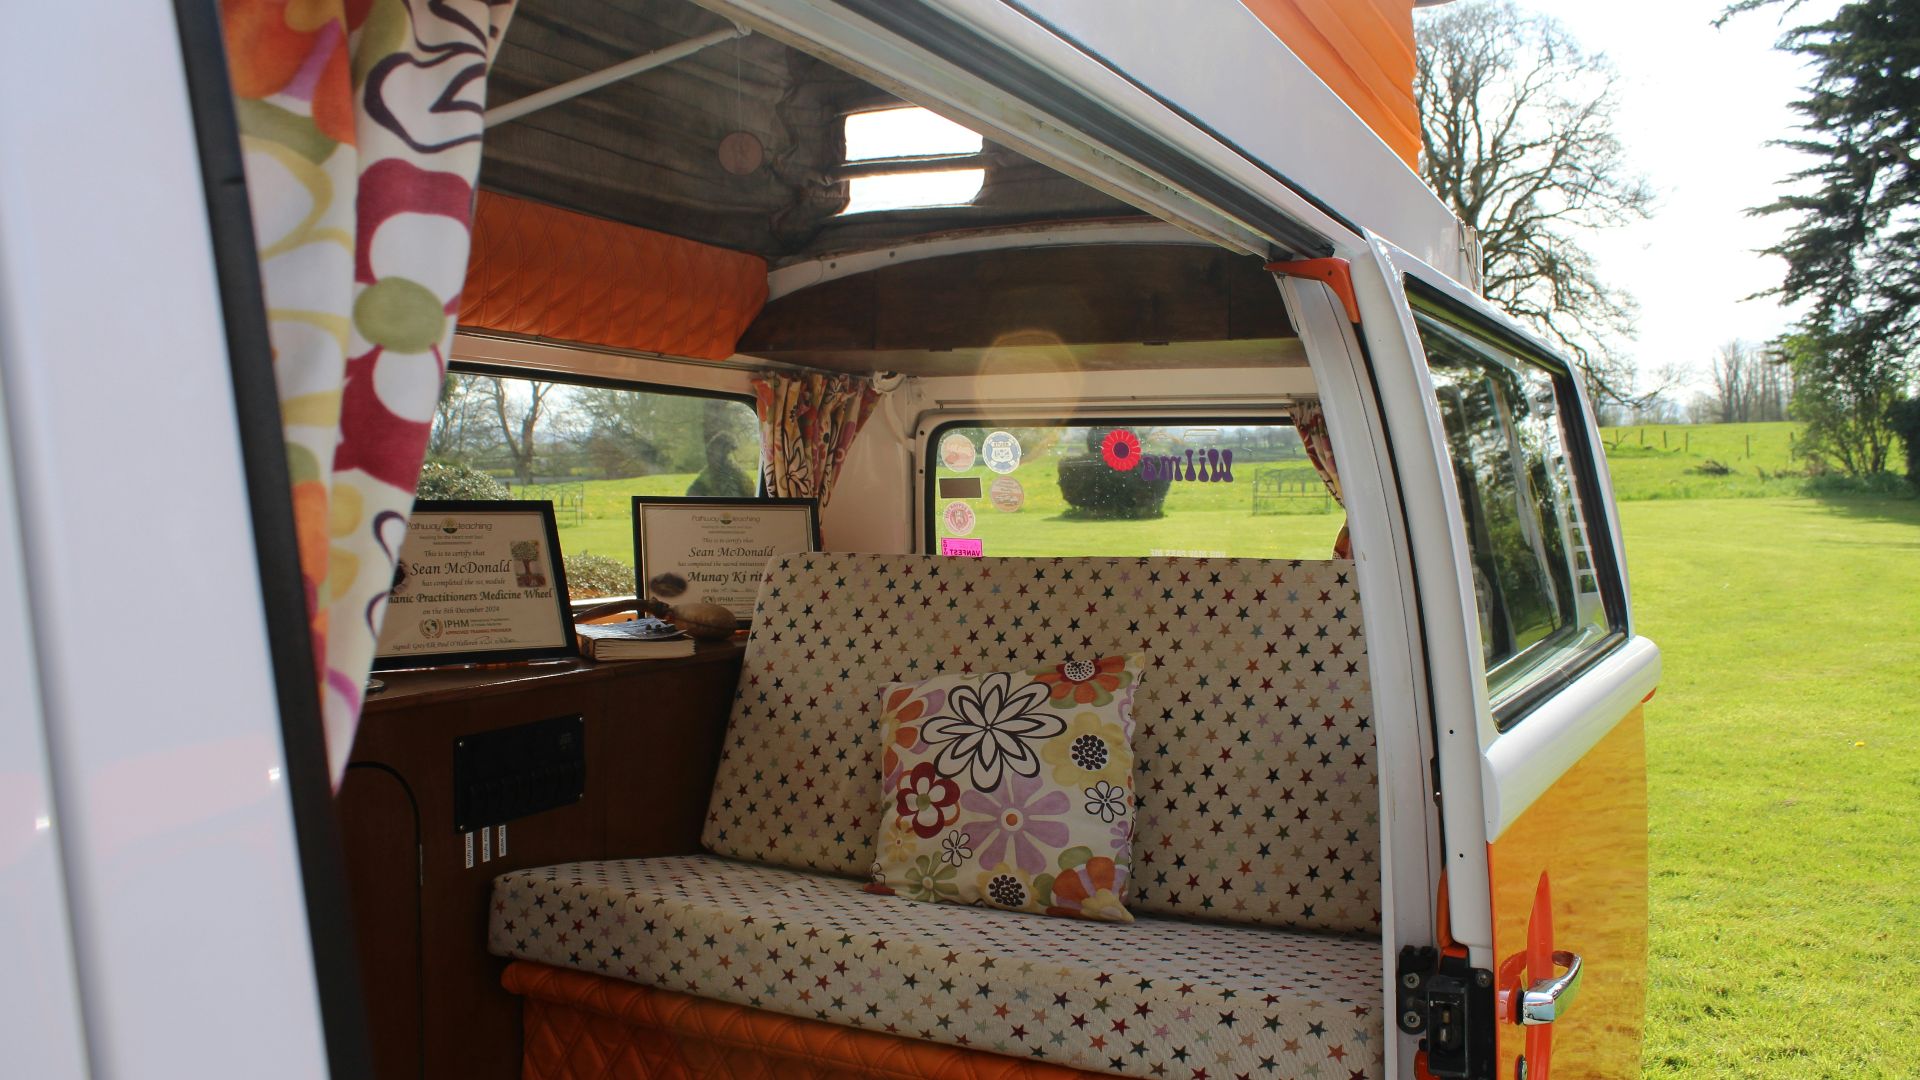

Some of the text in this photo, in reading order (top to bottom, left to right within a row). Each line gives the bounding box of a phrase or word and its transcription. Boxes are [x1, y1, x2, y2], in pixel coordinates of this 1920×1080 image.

[688, 545, 776, 558] Sean McDonald
[410, 559, 512, 576] Sean McDonald
[687, 571, 729, 586] Munay
[731, 570, 747, 584] Ki
[415, 592, 478, 604] Practitioners
[479, 589, 521, 602] Medicine
[523, 587, 553, 600] Wheel
[454, 607, 484, 615] December
[444, 619, 470, 629] IPHM
